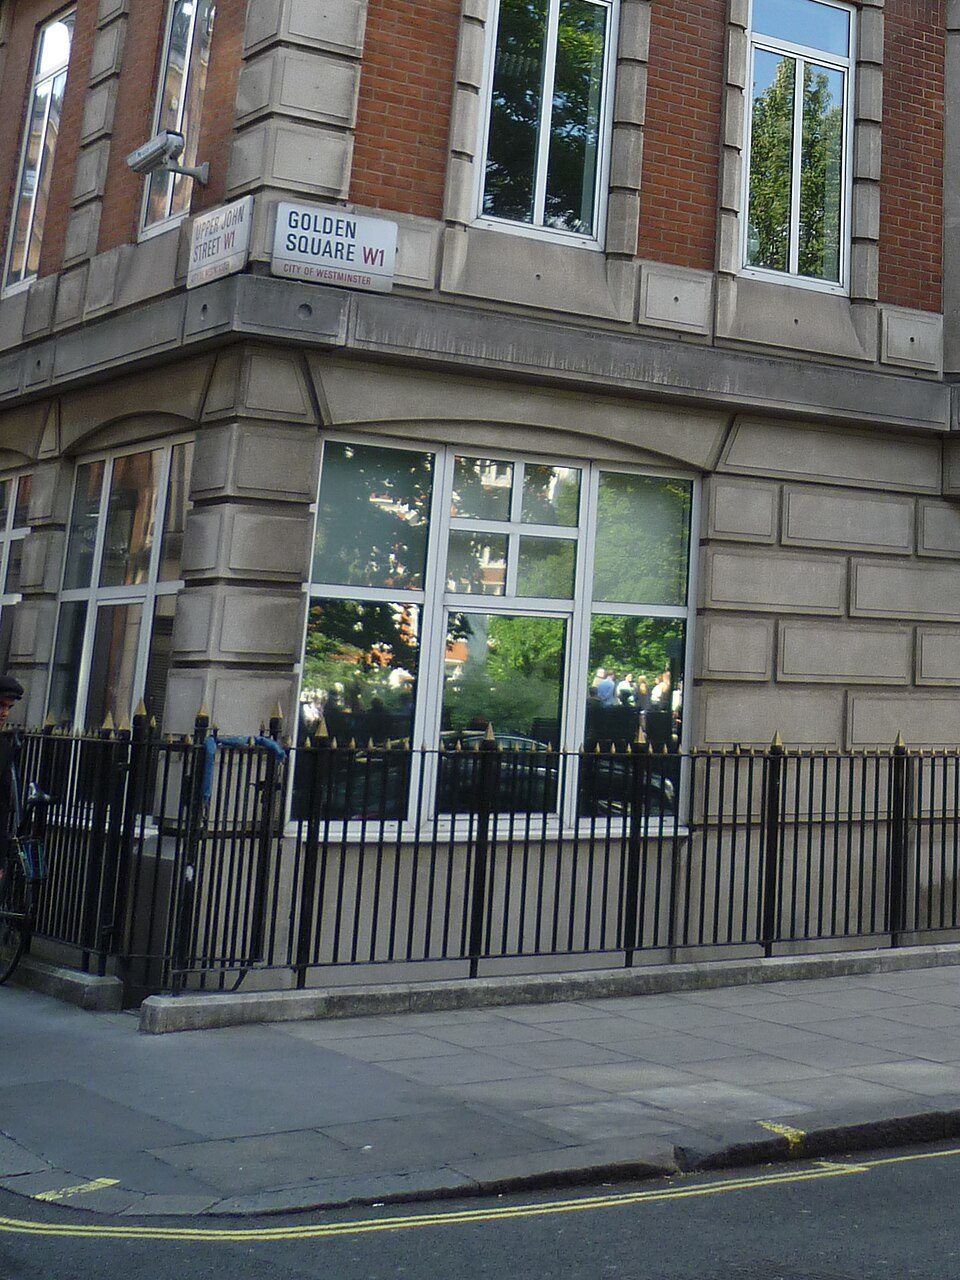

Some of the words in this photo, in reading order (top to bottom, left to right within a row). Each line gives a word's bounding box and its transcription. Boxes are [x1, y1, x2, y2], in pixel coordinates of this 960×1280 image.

[195, 216, 220, 241] UPPER
[221, 205, 244, 230] JOHN
[288, 209, 357, 239] GOLDEN
[194, 236, 221, 263] STREET
[224, 230, 235, 250] W1
[285, 232, 356, 262] SQUARE
[362, 246, 385, 267] W1
[283, 263, 302, 273] CITY
[304, 266, 314, 275] OF
[316, 268, 371, 285] WESTMINSTER
